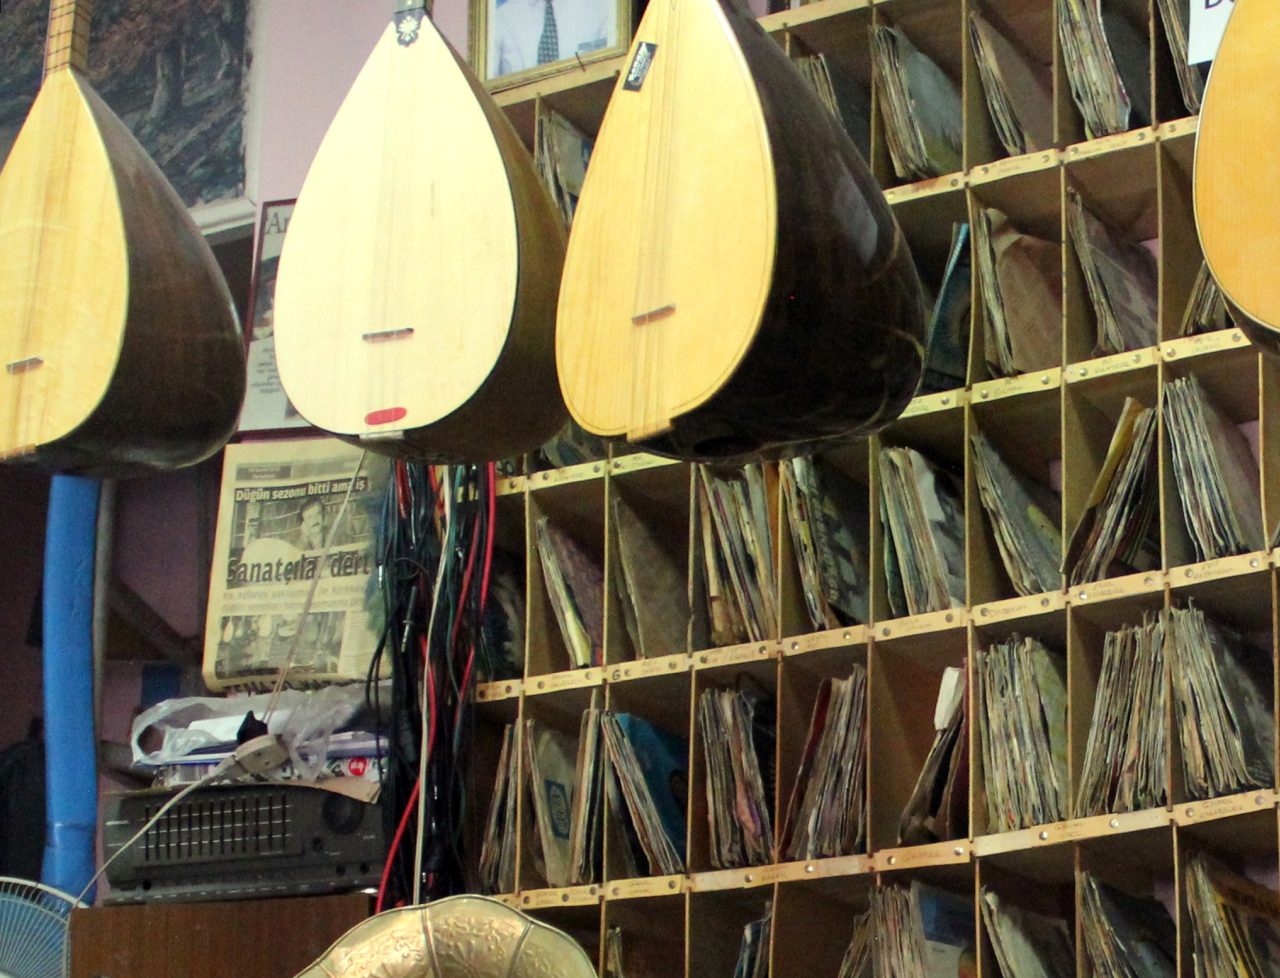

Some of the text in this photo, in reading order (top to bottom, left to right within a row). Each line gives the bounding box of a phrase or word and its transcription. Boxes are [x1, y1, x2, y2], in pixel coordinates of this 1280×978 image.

[272, 486, 306, 500] sezonu
[308, 481, 330, 495] bitti
[226, 552, 325, 586] Sanatçıla
